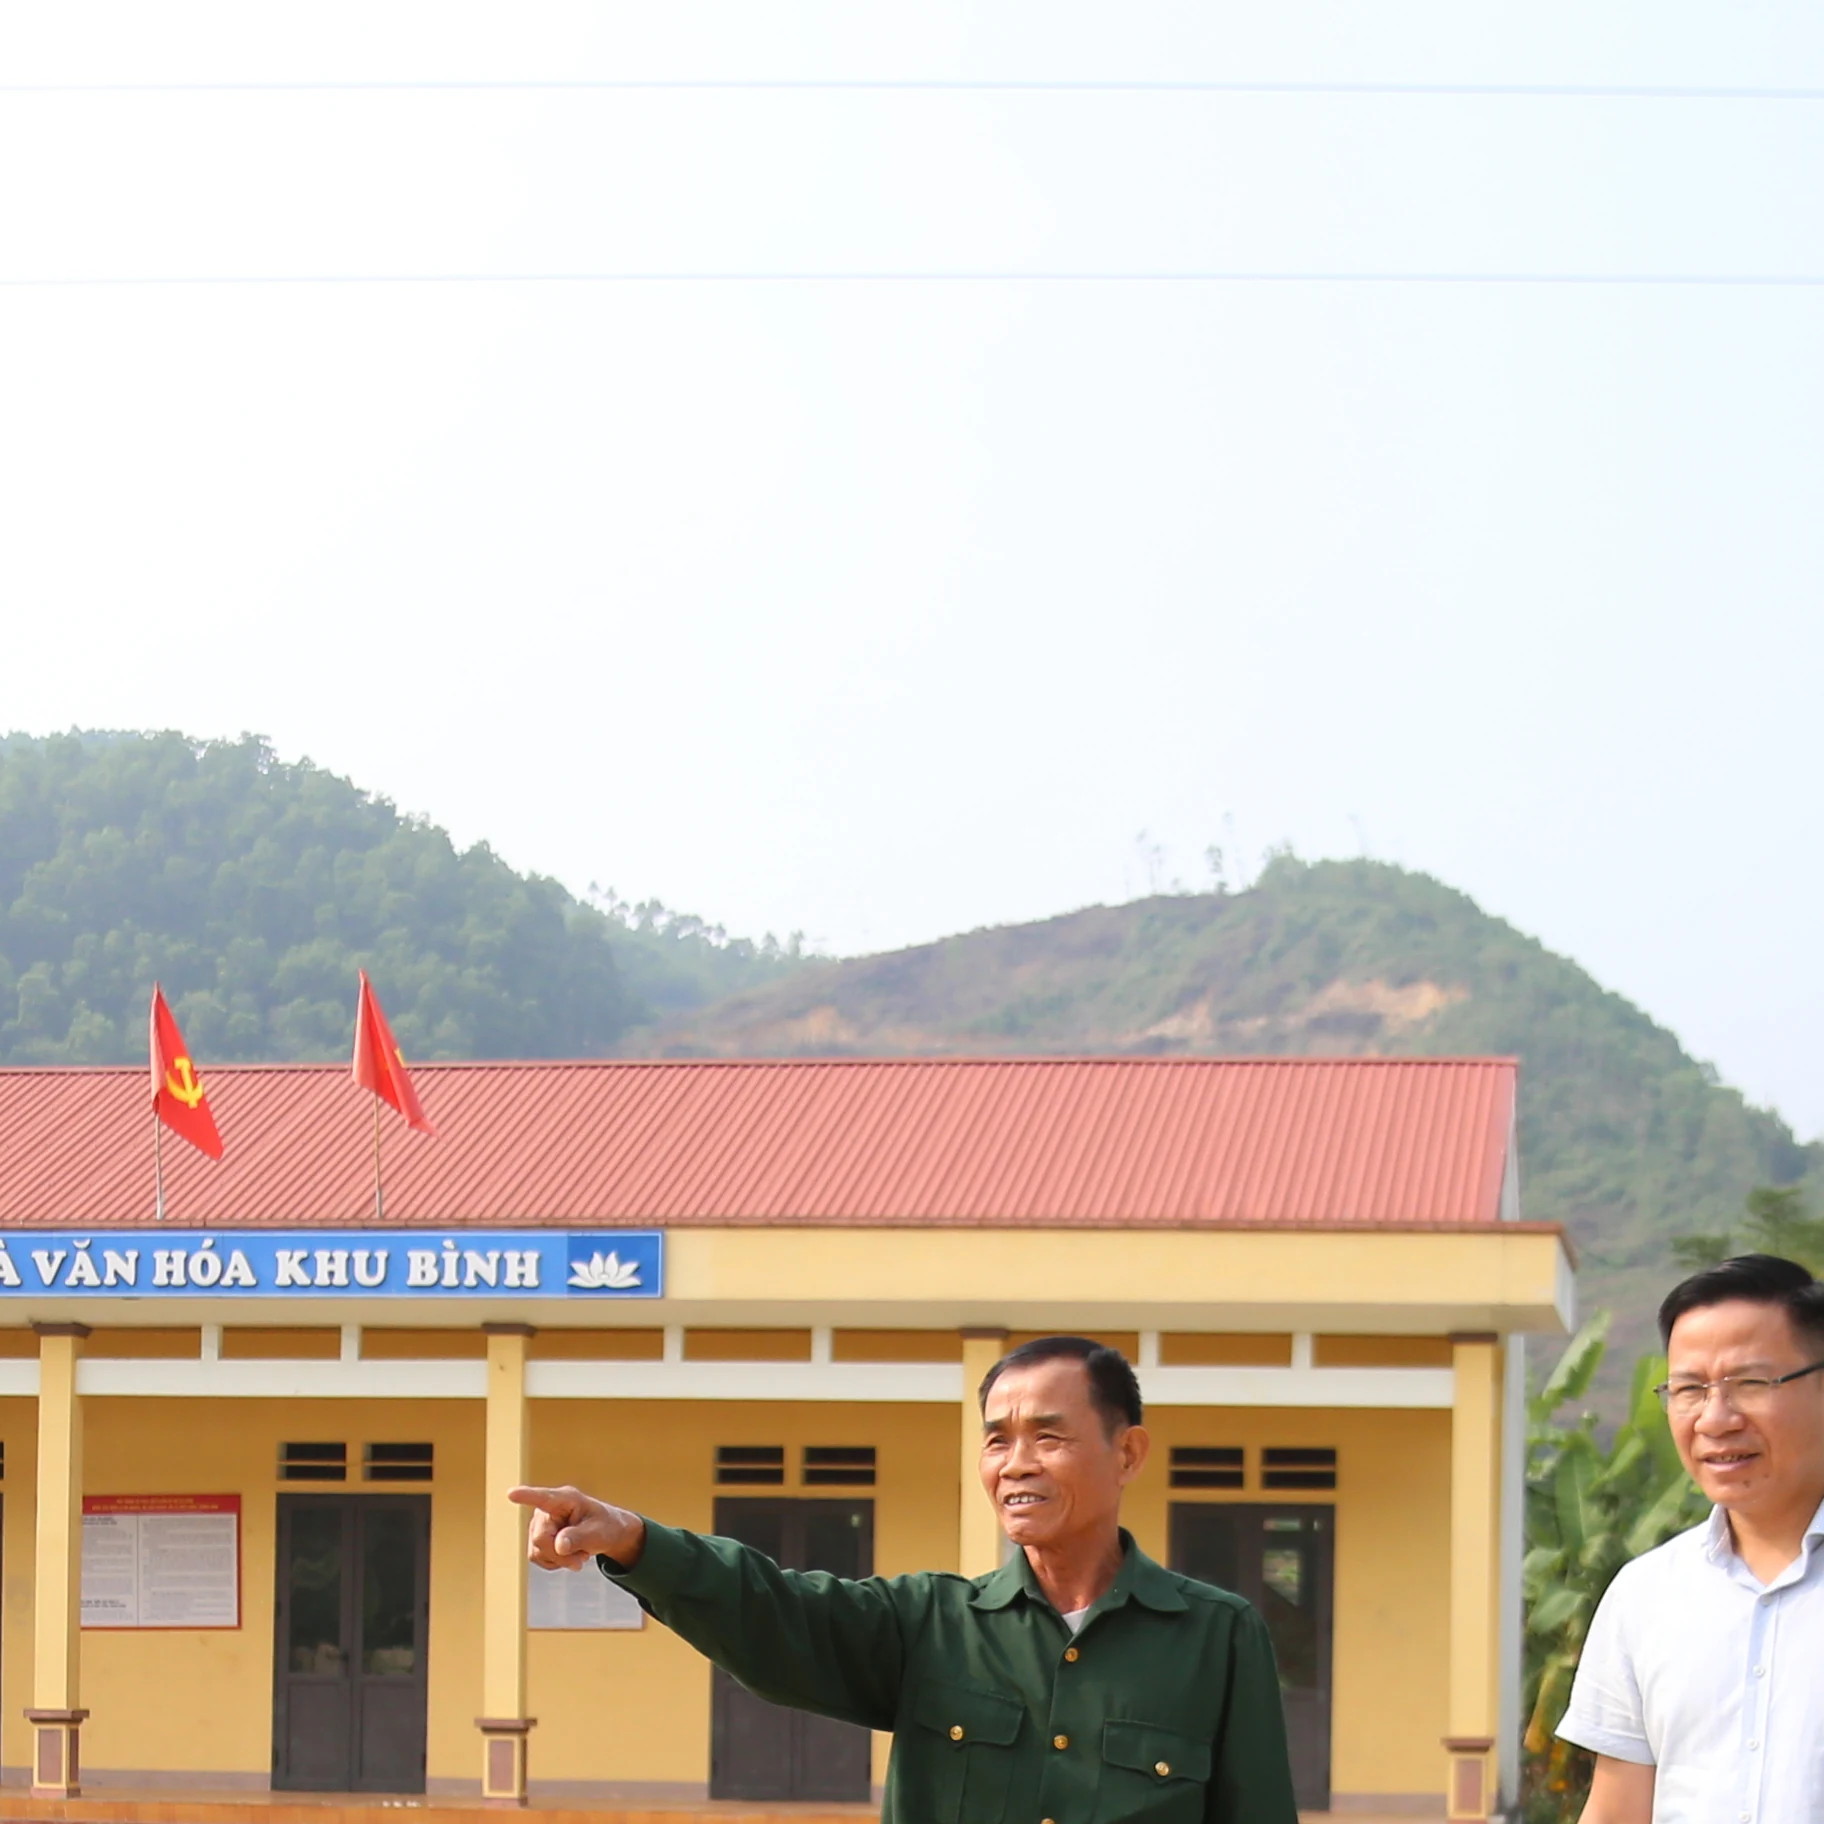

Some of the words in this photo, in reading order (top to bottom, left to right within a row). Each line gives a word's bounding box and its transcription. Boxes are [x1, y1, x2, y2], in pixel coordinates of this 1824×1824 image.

[31, 1237, 139, 1287] VĂN
[152, 1237, 257, 1287] HÓA
[274, 1249, 388, 1287] KHU
[406, 1238, 540, 1288] BÌNH
